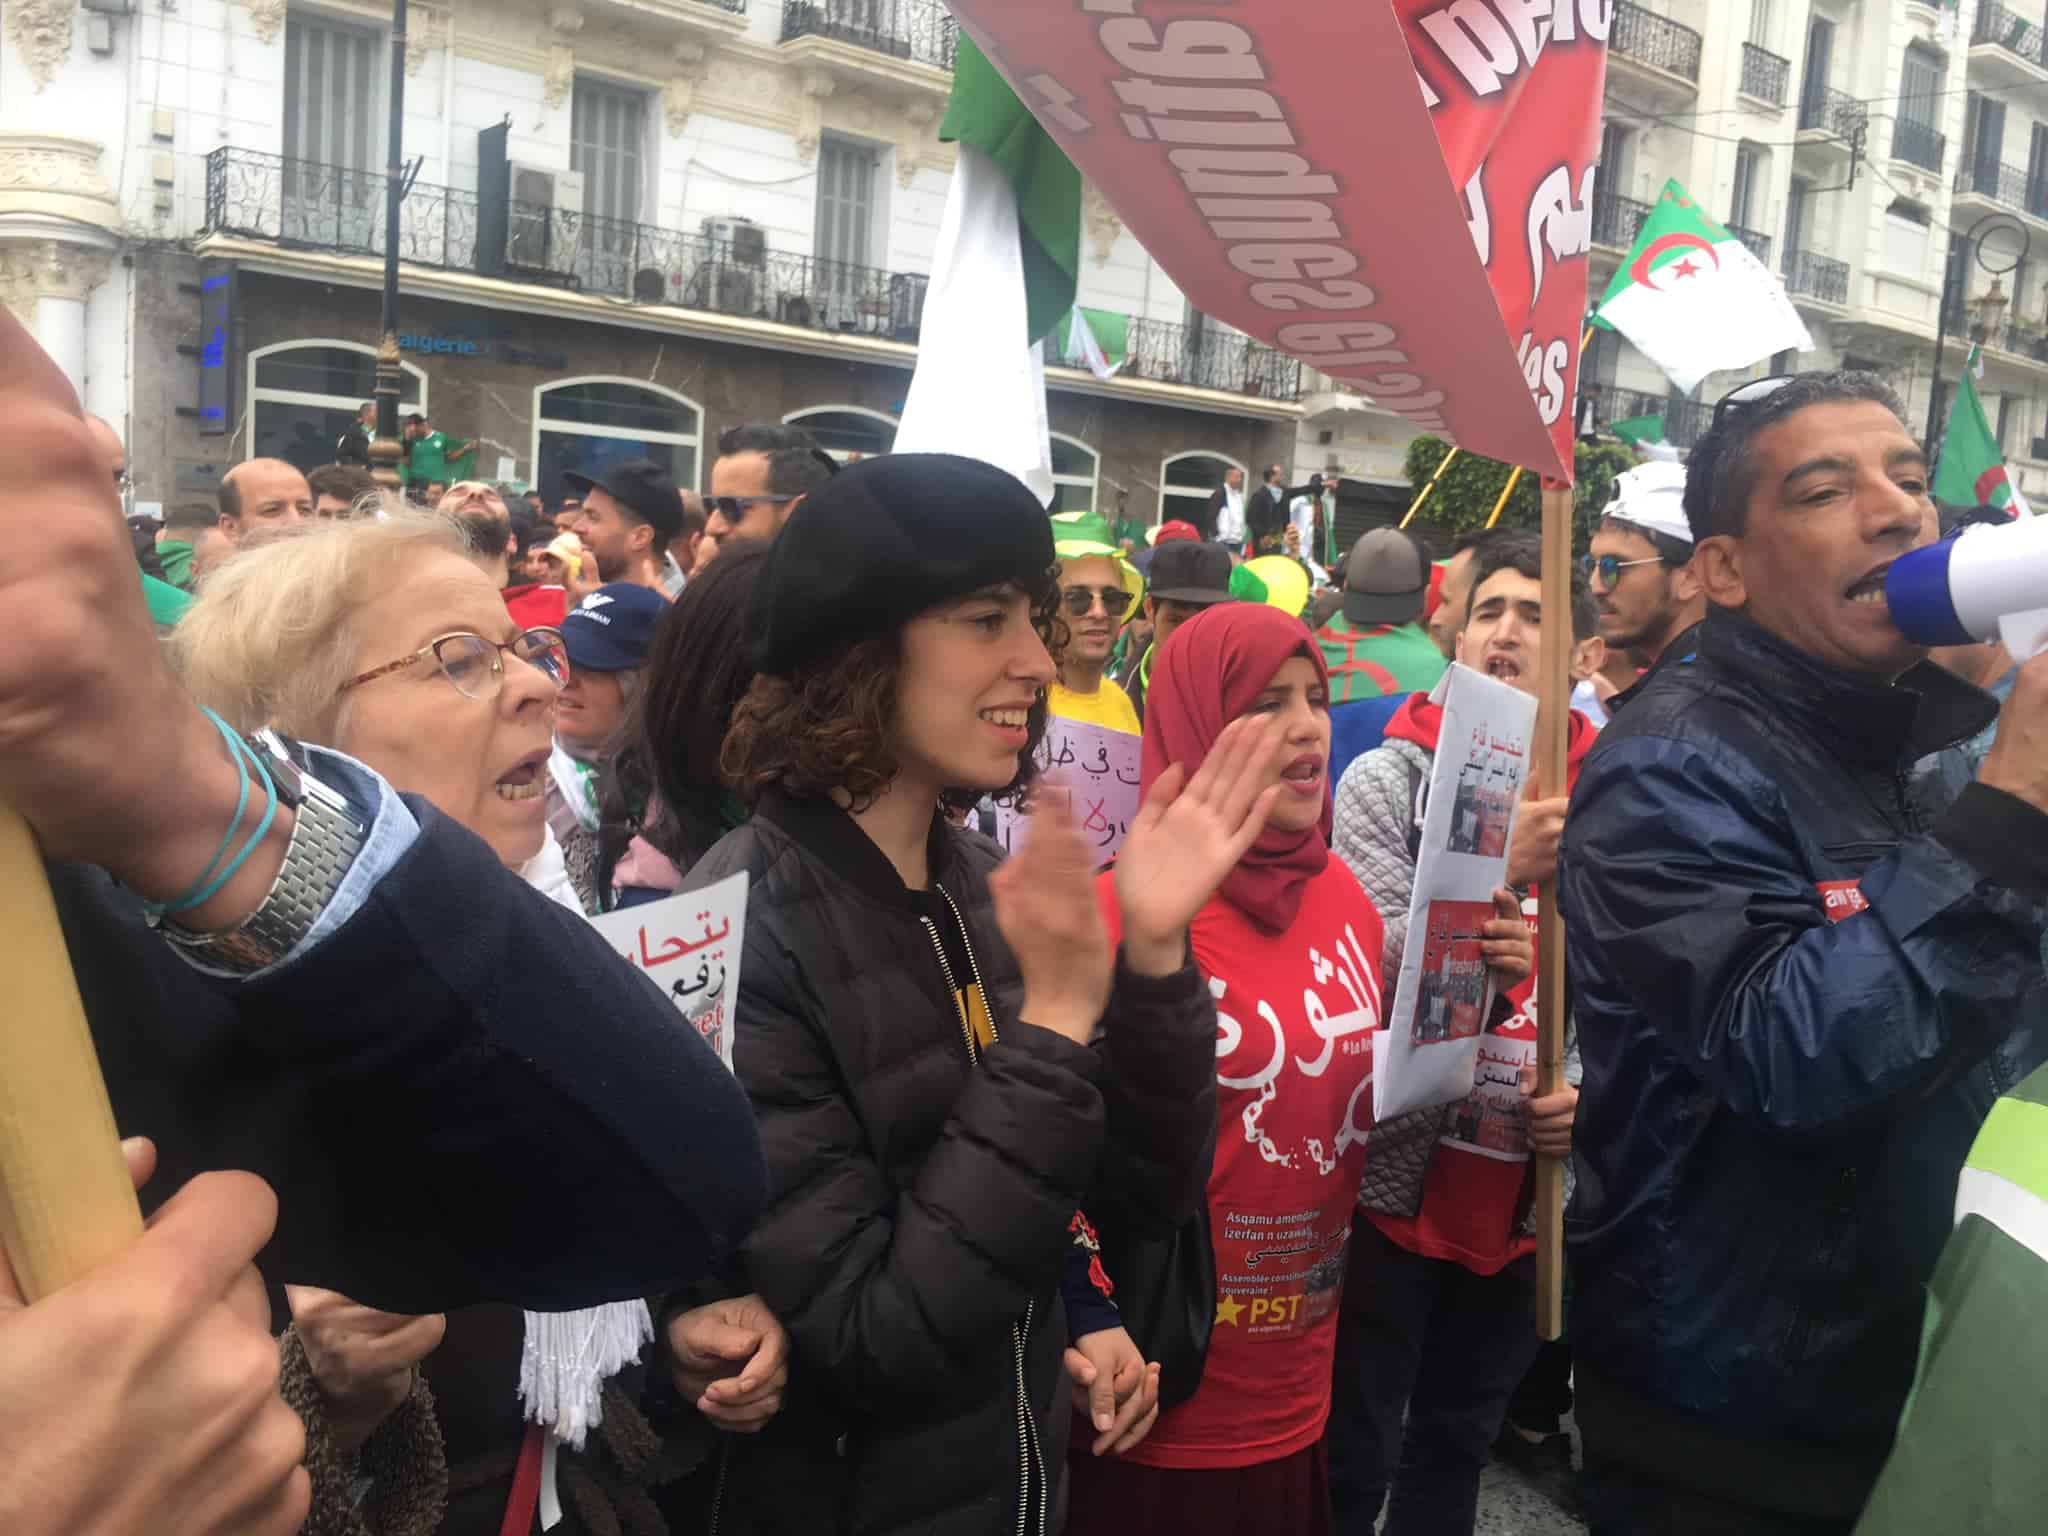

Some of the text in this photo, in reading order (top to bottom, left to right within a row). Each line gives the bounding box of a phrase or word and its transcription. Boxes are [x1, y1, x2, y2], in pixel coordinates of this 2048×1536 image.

[626, 910, 731, 968] يتحا
[1226, 1211, 1274, 1227] Asqamu
[1266, 1230, 1275, 1241] n
[1248, 1294, 1303, 1325] PST
